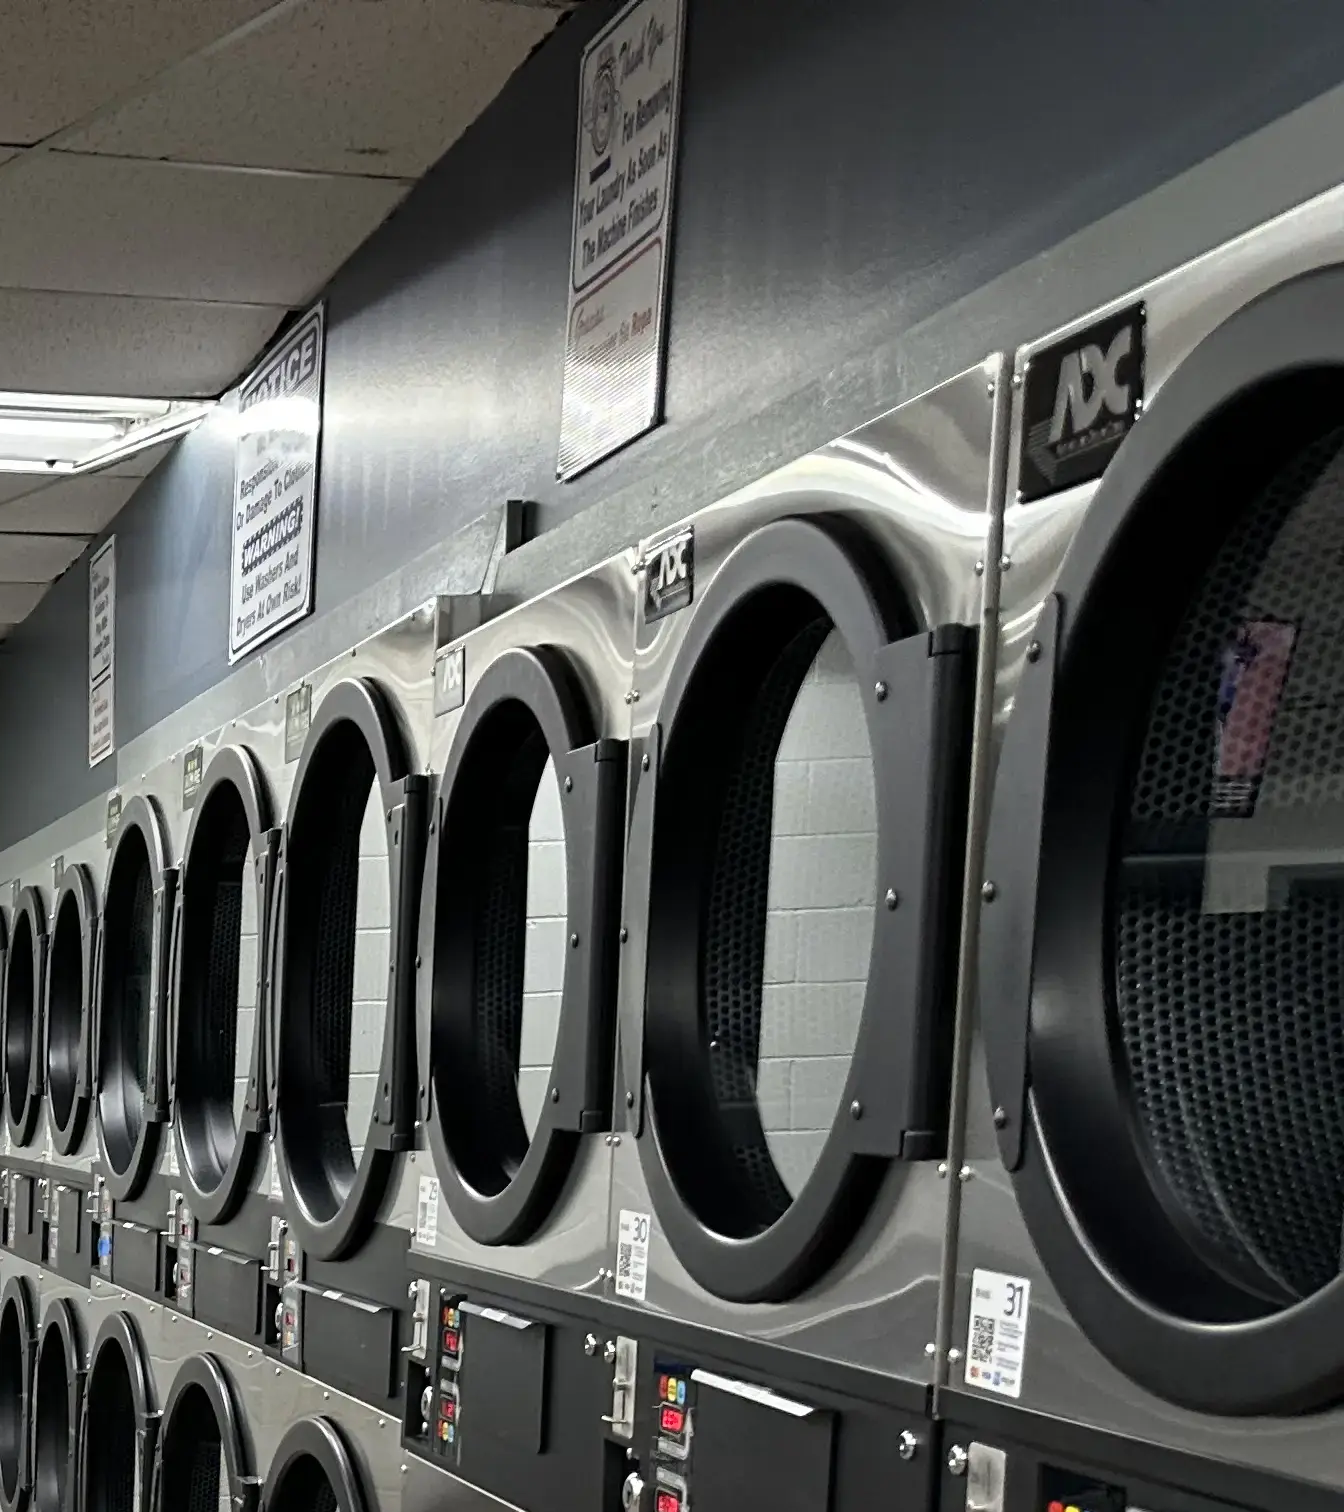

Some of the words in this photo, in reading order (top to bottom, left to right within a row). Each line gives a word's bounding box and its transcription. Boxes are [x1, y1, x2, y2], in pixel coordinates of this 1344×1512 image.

[621, 111, 634, 146] For
[596, 170, 626, 215] Laundry
[627, 157, 636, 188] As
[637, 143, 656, 179] Soon
[582, 237, 595, 270] The
[596, 213, 626, 258] Machine
[627, 187, 657, 233] Finishes
[246, 489, 272, 524] Damage
[274, 478, 282, 500] To
[244, 507, 300, 568] WARNING!
[242, 583, 253, 604] Use
[255, 561, 284, 595] Washers
[285, 544, 299, 573] And
[237, 610, 256, 637] Dryers
[257, 599, 265, 621] At
[266, 592, 281, 615] Own
[282, 573, 301, 604] Risk!
[633, 1216, 648, 1243] 30
[1003, 1282, 1024, 1319] 31
